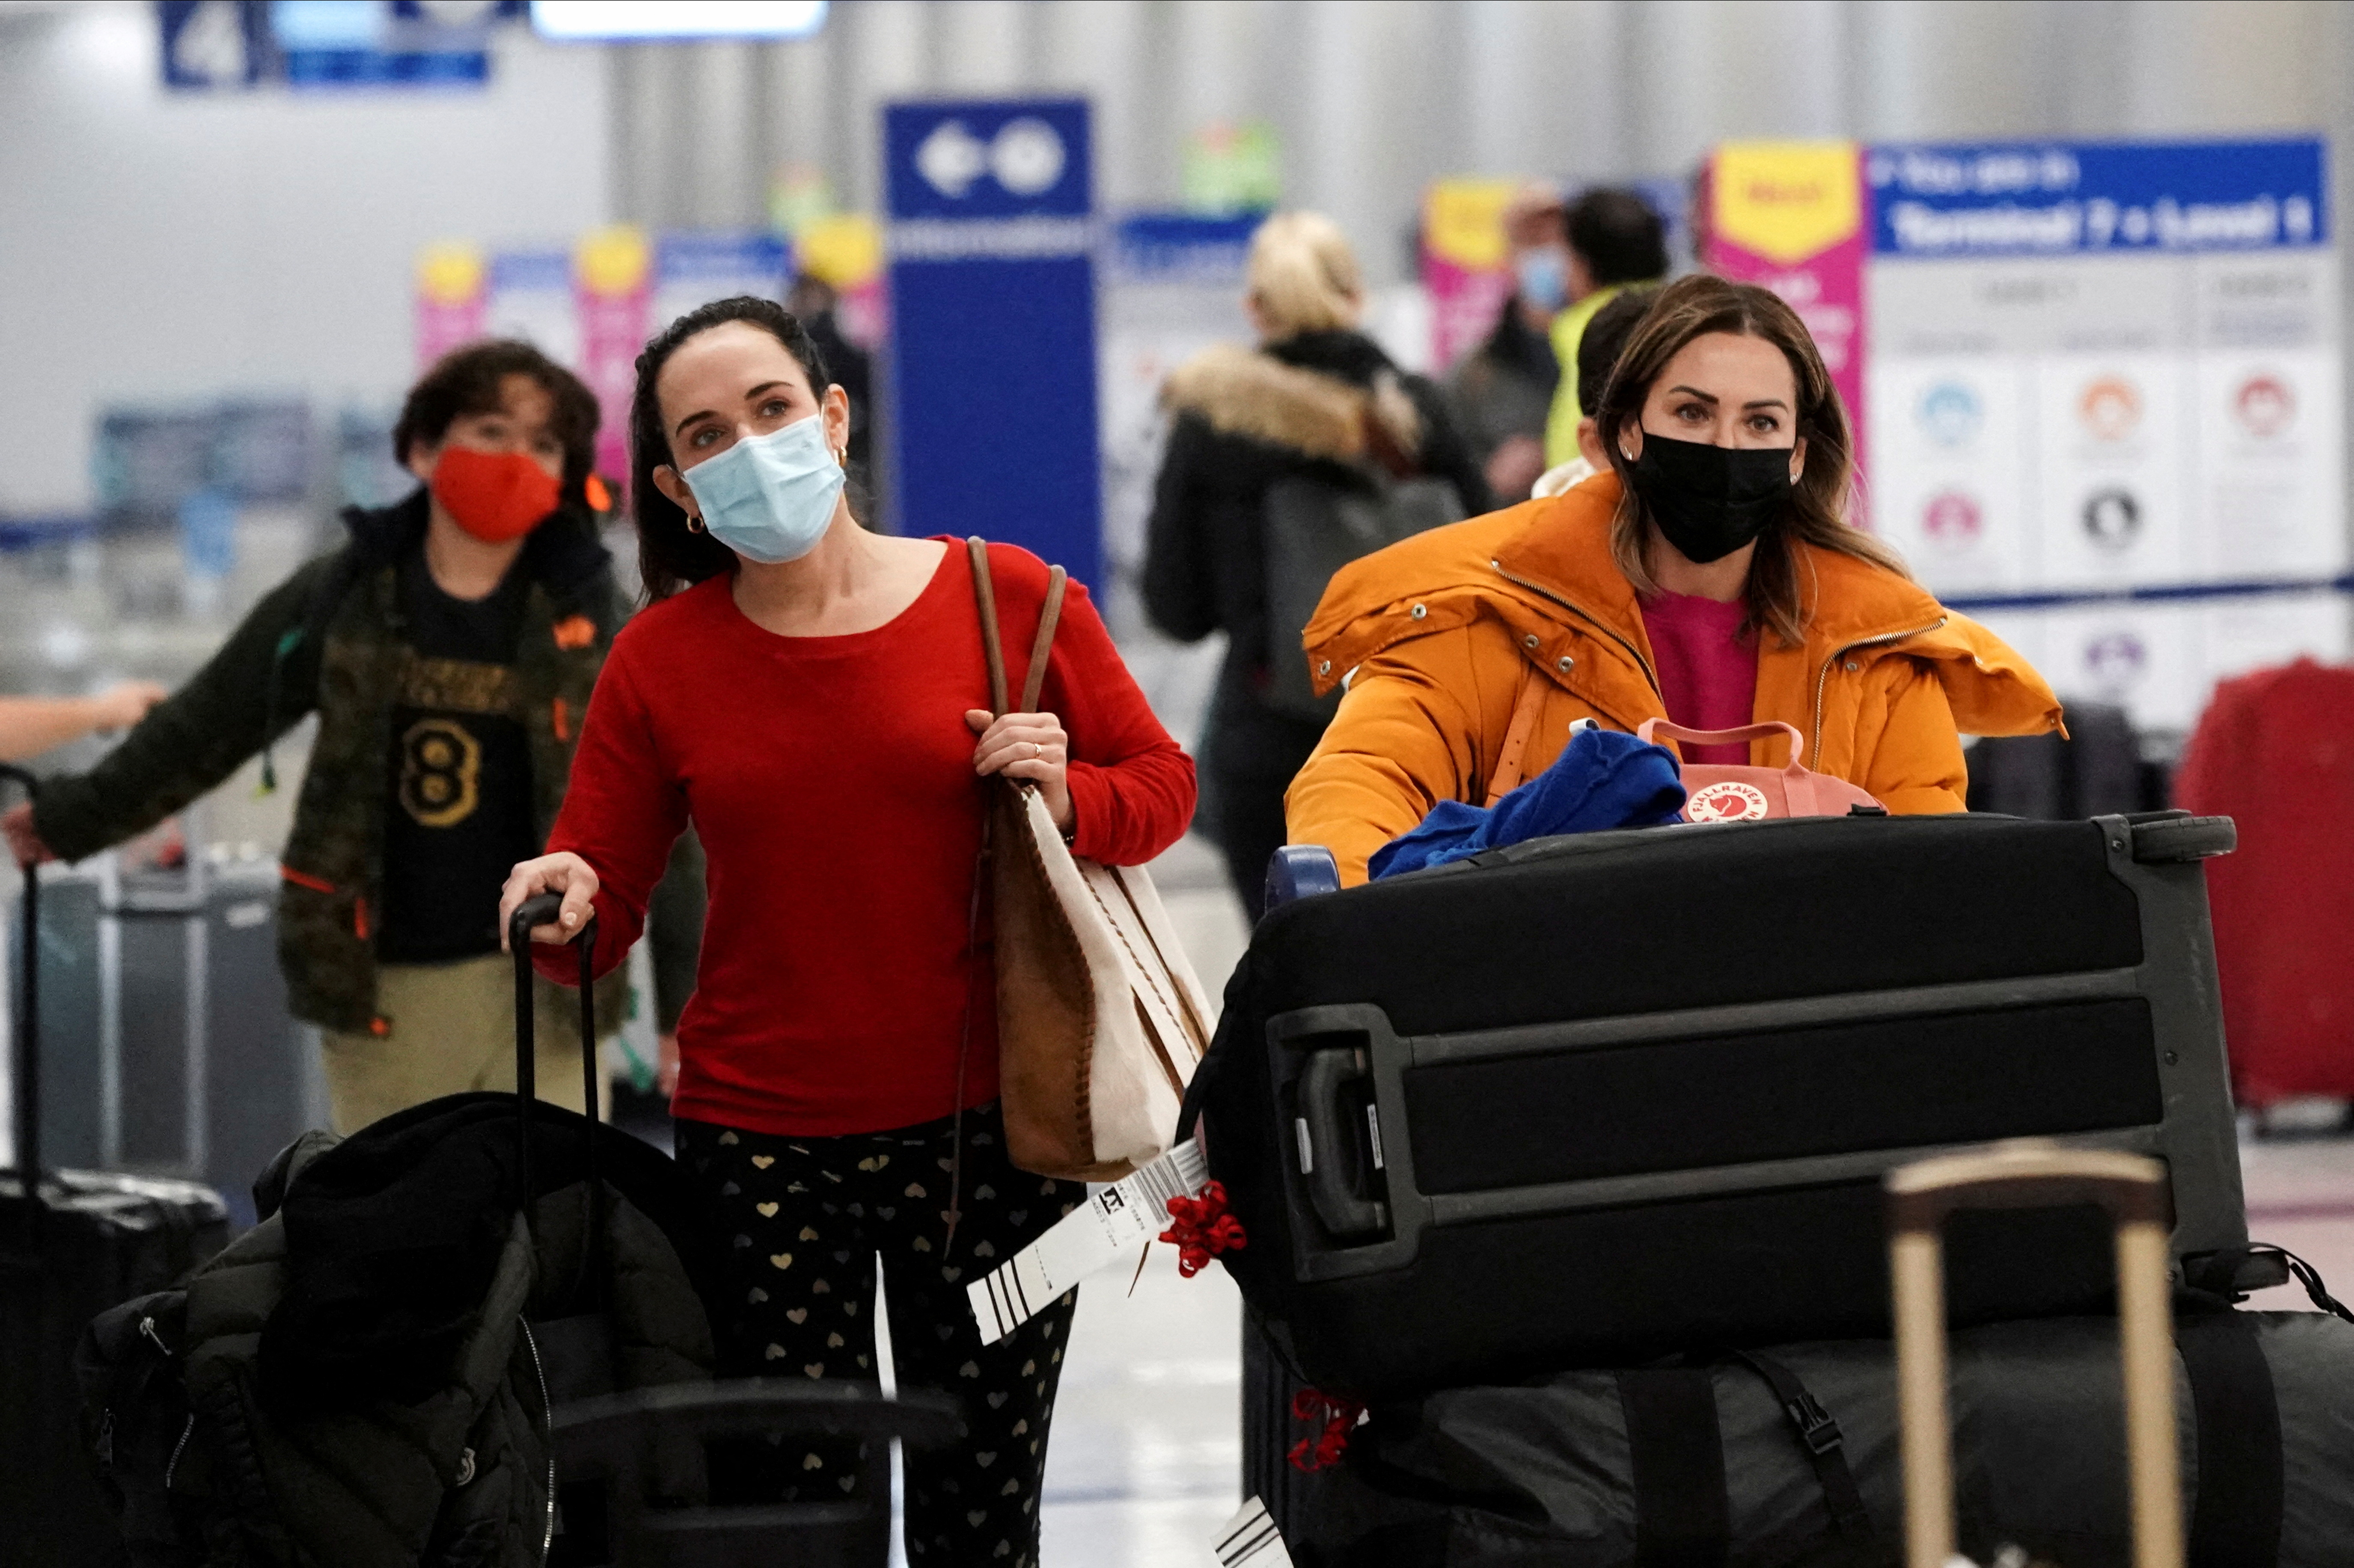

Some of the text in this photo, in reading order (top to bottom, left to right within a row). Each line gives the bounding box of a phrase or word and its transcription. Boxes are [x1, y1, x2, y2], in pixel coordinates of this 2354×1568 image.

[172, 1, 246, 74] 4
[1893, 203, 2078, 246] Terminal
[2157, 196, 2275, 243] Level
[2285, 194, 2310, 235] 1
[399, 719, 480, 828] 8
[1100, 1188, 1123, 1214] LAX
